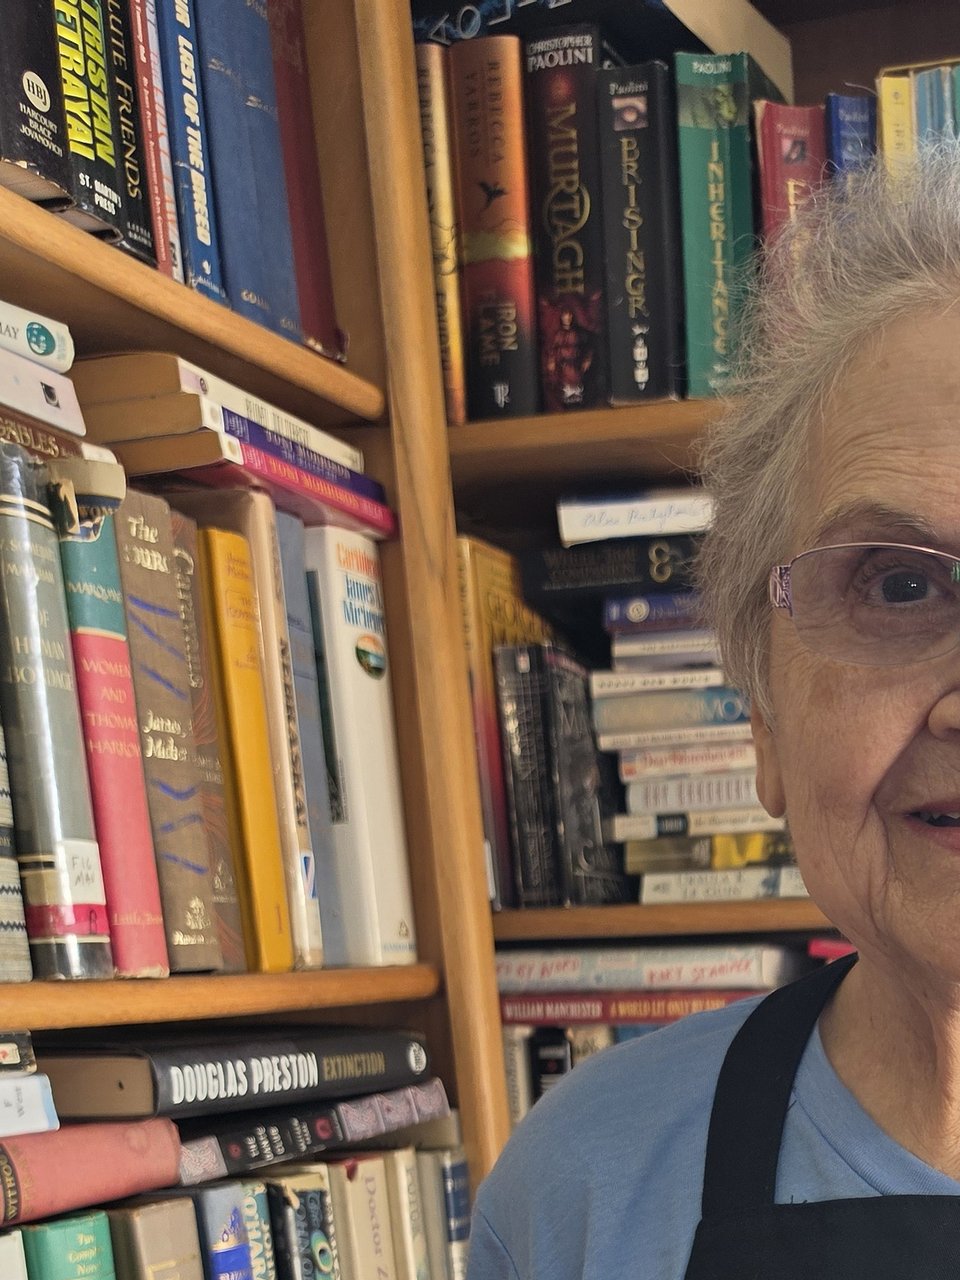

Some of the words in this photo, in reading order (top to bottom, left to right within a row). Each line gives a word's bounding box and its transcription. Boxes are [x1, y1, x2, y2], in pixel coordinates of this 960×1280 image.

[527, 48, 593, 73] PAOLINI
[528, 35, 592, 55] CHRISTOPHER
[178, 35, 197, 96] LAST
[27, 76, 47, 106] HBJ
[20, 103, 57, 134] HARCOURT
[183, 92, 199, 127] OF
[20, 126, 63, 157] JOVANOVICH
[29, 118, 53, 140] BRACE
[116, 77, 142, 199] FRIENDS
[187, 125, 204, 172] THE
[79, 173, 92, 190] ST.
[546, 101, 591, 295] MURTAGH
[191, 166, 211, 246] BREED
[620, 138, 650, 319] BRISINGR
[707, 138, 731, 356] INHERITANCE
[498, 302, 518, 350] IRON
[128, 514, 160, 544] The
[81, 657, 131, 678] WOMEN
[101, 687, 128, 704] AND
[170, 1059, 249, 1105] DOUGLAS
[250, 1051, 320, 1095] PRESTON
[322, 1050, 387, 1081] EXTINCTION
[363, 1175, 382, 1257] Doctor
